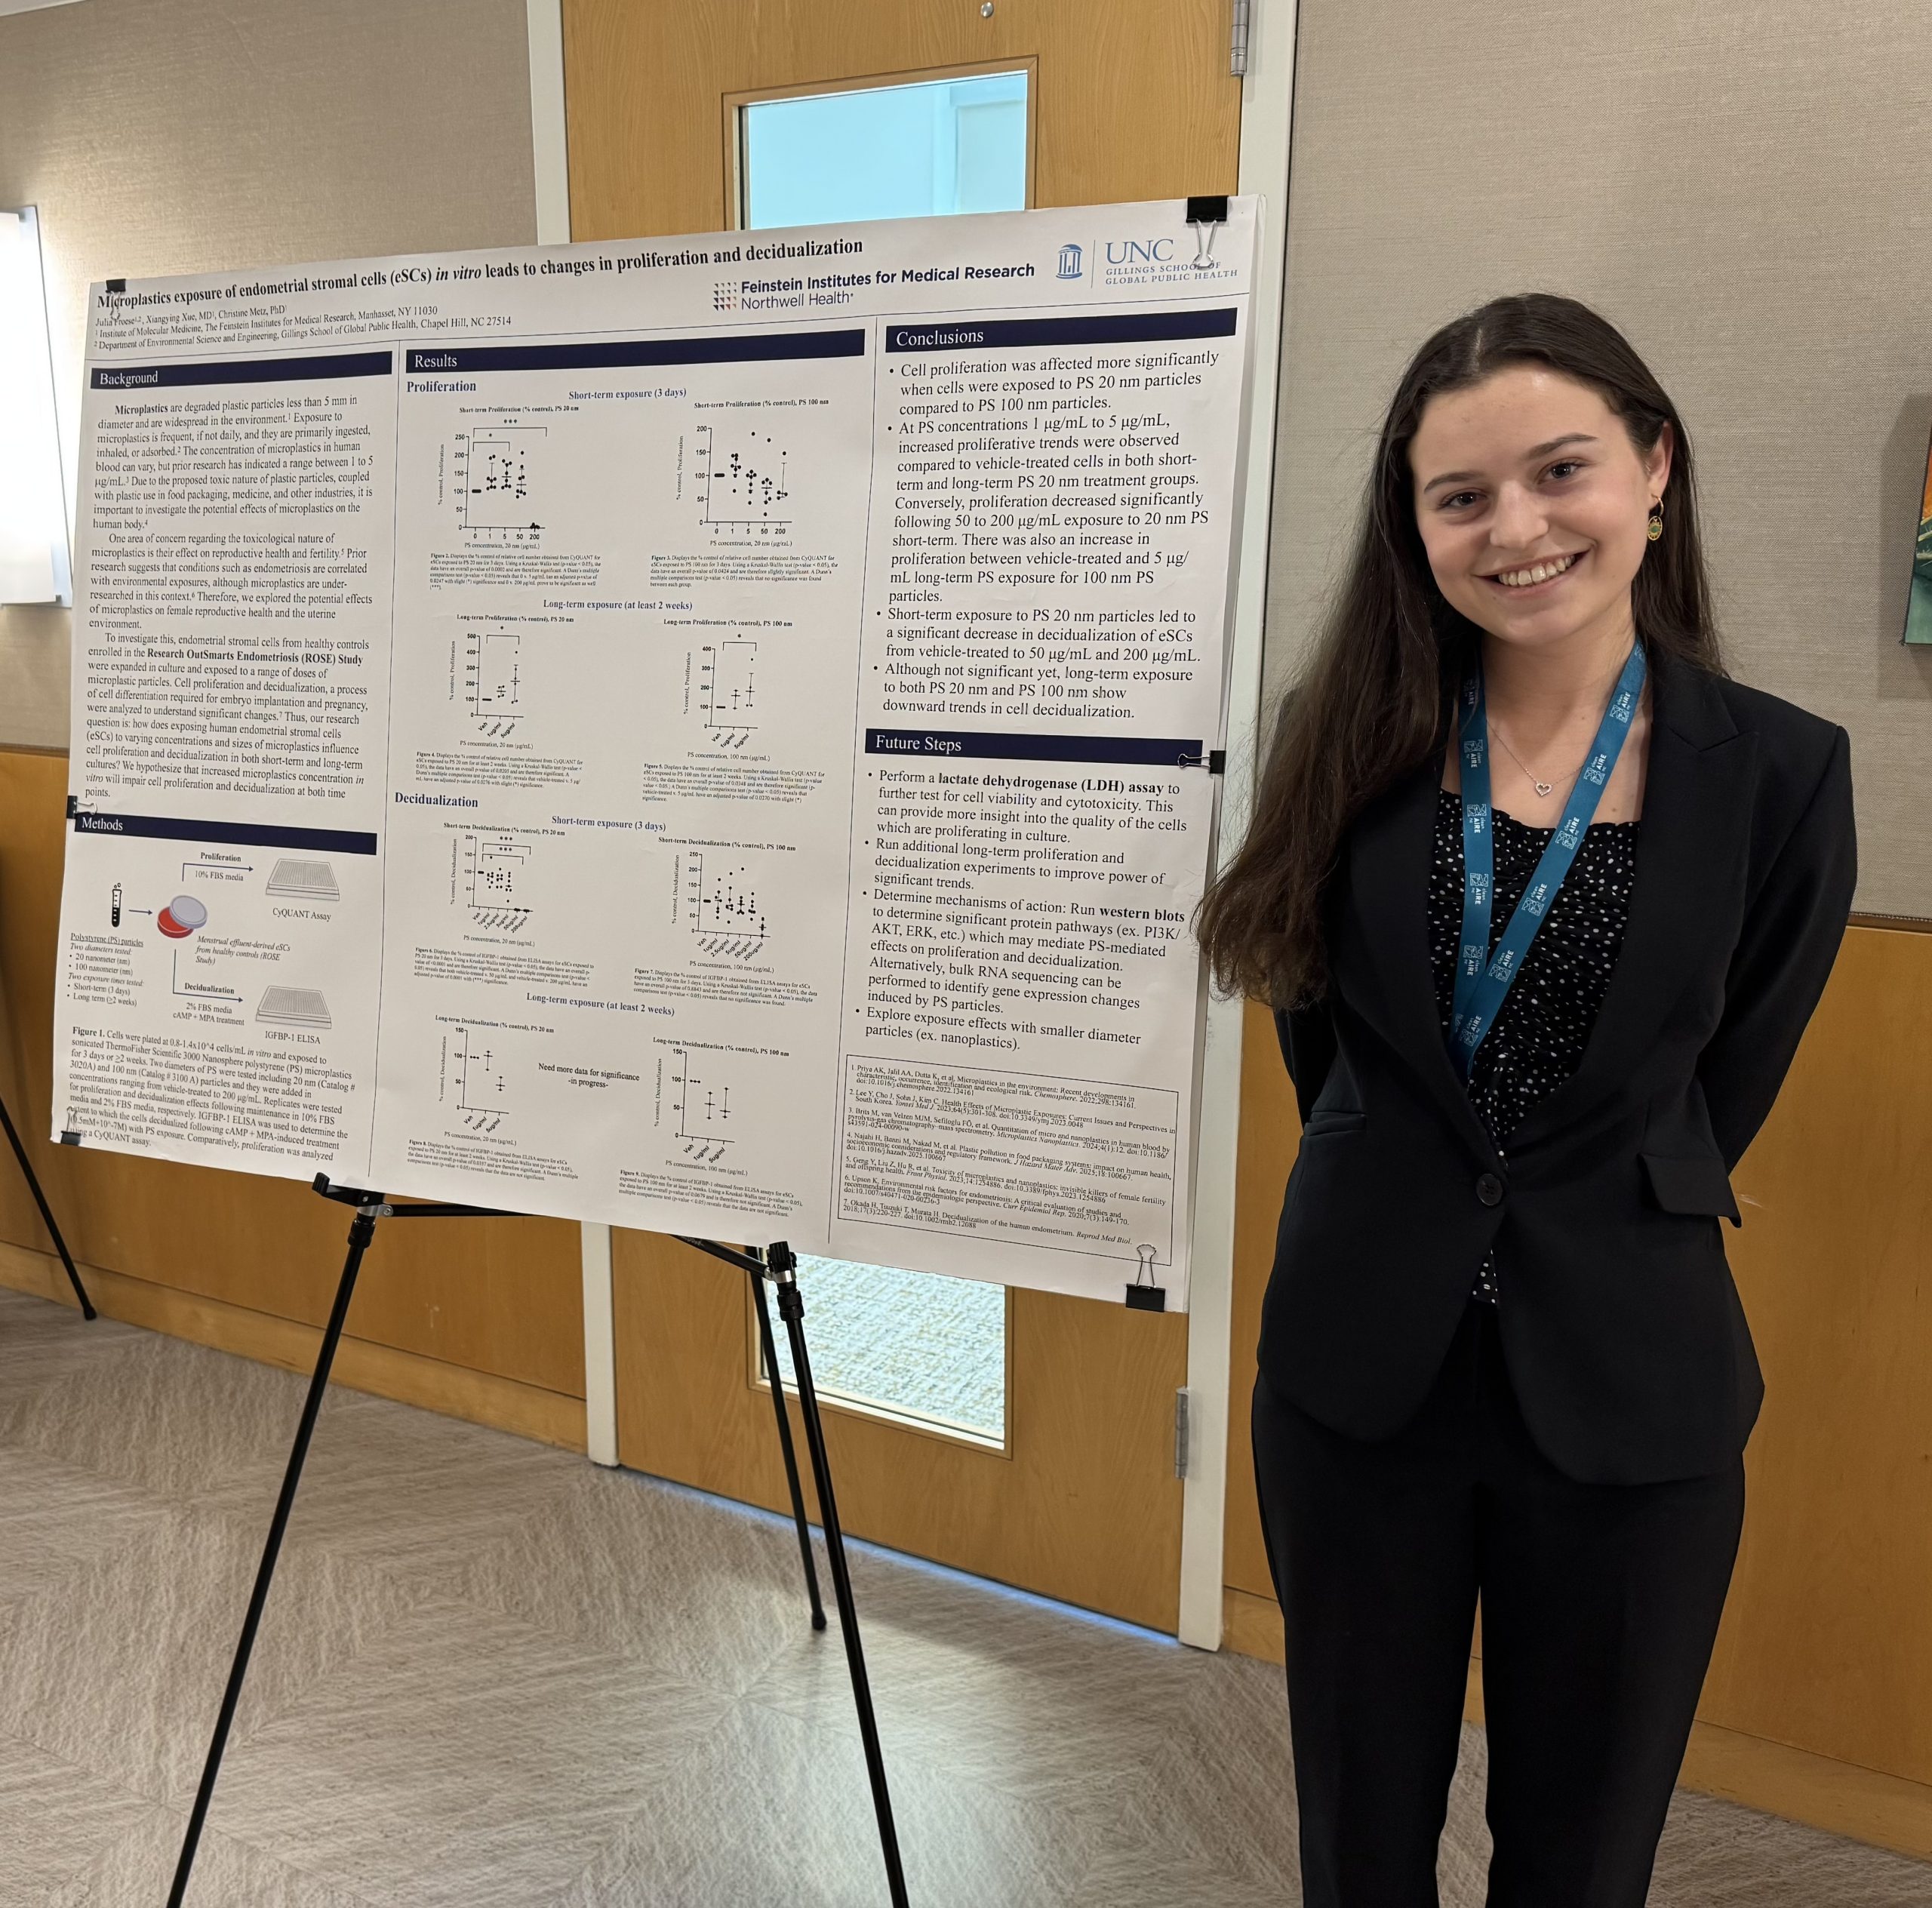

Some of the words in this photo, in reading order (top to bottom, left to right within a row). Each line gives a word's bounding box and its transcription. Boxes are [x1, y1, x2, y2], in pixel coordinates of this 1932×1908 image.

[1106, 238, 1173, 263] UNC
[174, 289, 222, 305] exposure
[225, 284, 236, 297] of
[239, 278, 308, 297] endometrial
[312, 273, 357, 290] stromal
[361, 272, 386, 286] cells
[390, 268, 432, 286] (eSCs)
[435, 266, 448, 281] in
[453, 266, 481, 279] vitro
[485, 262, 518, 278] leads
[523, 263, 536, 275] to
[540, 260, 595, 276] changes
[599, 256, 612, 270] in
[617, 250, 708, 273] proliferation
[713, 246, 741, 263] and
[746, 238, 862, 260] decidualization
[741, 278, 802, 294] Feinstein
[808, 274, 871, 289] Institutes
[875, 271, 897, 284] for
[902, 266, 959, 282] Medical
[964, 263, 1034, 279] Research
[1106, 266, 1155, 275] GILLINGS
[1106, 276, 1146, 285] GLOBAL
[1152, 273, 1189, 282] PUBLIC
[1195, 269, 1237, 279] HEALTH
[741, 294, 804, 309] Northwell
[127, 328, 137, 336] of
[137, 325, 169, 336] Molecular
[170, 322, 203, 334] Medicine,
[205, 323, 218, 331] The
[218, 322, 250, 331] Feinstein
[251, 319, 281, 329] Institutes
[283, 316, 293, 326] for
[294, 314, 321, 325] Medical
[324, 312, 356, 323] Research,
[358, 309, 396, 319] Manhasset,
[397, 306, 412, 316] NY
[414, 306, 438, 315] 11030
[897, 328, 983, 346] Conclusions
[415, 354, 457, 368] Results
[901, 363, 925, 376] Cell
[931, 360, 1006, 377] proliferation
[1011, 362, 1035, 371] was
[1040, 356, 1092, 370] affected
[1097, 359, 1131, 368] more
[1135, 350, 1219, 368] significantly
[100, 370, 158, 386] Background
[407, 380, 475, 392] Proliferation
[568, 391, 613, 399] Short-term
[616, 391, 652, 400] exposure
[654, 388, 662, 398] (3
[664, 388, 686, 399] days)
[114, 403, 168, 416] Microplastics
[183, 401, 220, 414] degraded
[221, 400, 249, 412] plastic
[251, 399, 285, 411] particles
[286, 398, 302, 408] less
[303, 396, 322, 406] than
[323, 395, 330, 405] 5
[349, 394, 358, 405] in
[543, 599, 584, 609] Long-term
[624, 601, 635, 610] (at
[638, 601, 655, 609] least
[666, 602, 692, 611] weeks)
[711, 732, 721, 743] Veh
[876, 734, 920, 749] Future
[924, 737, 961, 755] Steps
[1596, 753, 1607, 770] AIRE
[880, 770, 924, 782] Perform
[939, 772, 979, 785] lactate
[983, 775, 1077, 791] dehydrogenase
[1081, 779, 1124, 794] (LDH)
[1128, 784, 1164, 796] assay
[1168, 784, 1180, 794] to
[395, 792, 478, 807] Decidualization
[82, 817, 123, 831] Methods
[1473, 817, 1481, 834] AIRE
[1568, 816, 1580, 834] AIRE
[201, 852, 241, 862] Proliferation
[209, 871, 224, 879] FBS
[1536, 883, 1548, 900] AIRE
[272, 907, 310, 918] CyQUANT
[309, 912, 331, 922] Assay
[1503, 949, 1515, 967] AIRE
[1466, 959, 1475, 976] AIRE
[184, 983, 234, 994] Decidualization
[1470, 1015, 1482, 1032] AIRE
[264, 1030, 294, 1041] IGFBP-1
[297, 1034, 321, 1044] ELISA
[537, 1063, 555, 1071] Need
[589, 1068, 600, 1076] for
[600, 1070, 640, 1081] significance
[577, 1079, 609, 1088] progress-
